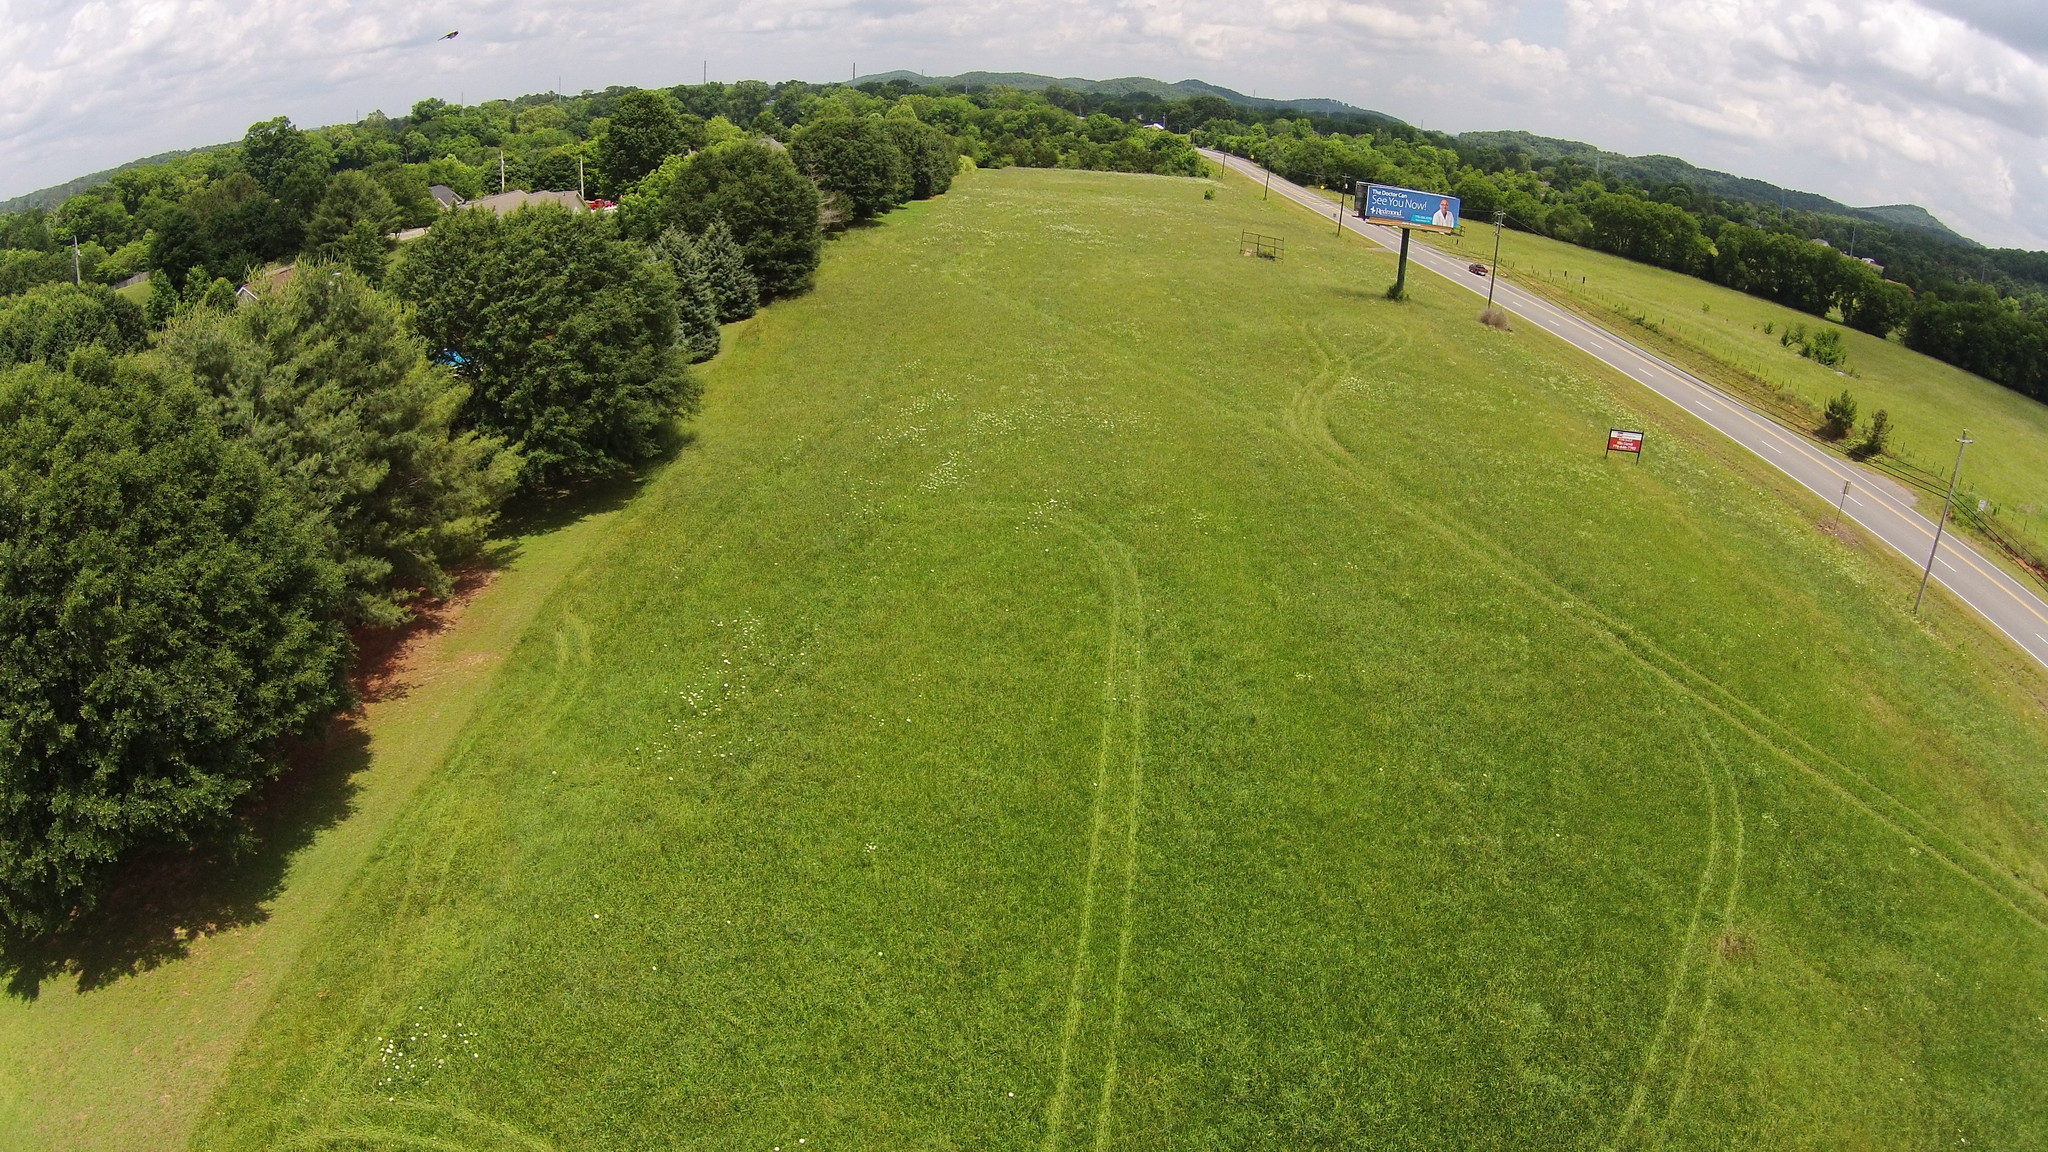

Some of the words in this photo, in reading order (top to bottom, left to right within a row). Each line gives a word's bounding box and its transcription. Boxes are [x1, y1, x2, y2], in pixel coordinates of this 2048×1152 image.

[1372, 195, 1387, 206] See
[1389, 197, 1404, 208] You
[1405, 199, 1427, 210] Now!
[1376, 208, 1402, 216] Redmond
